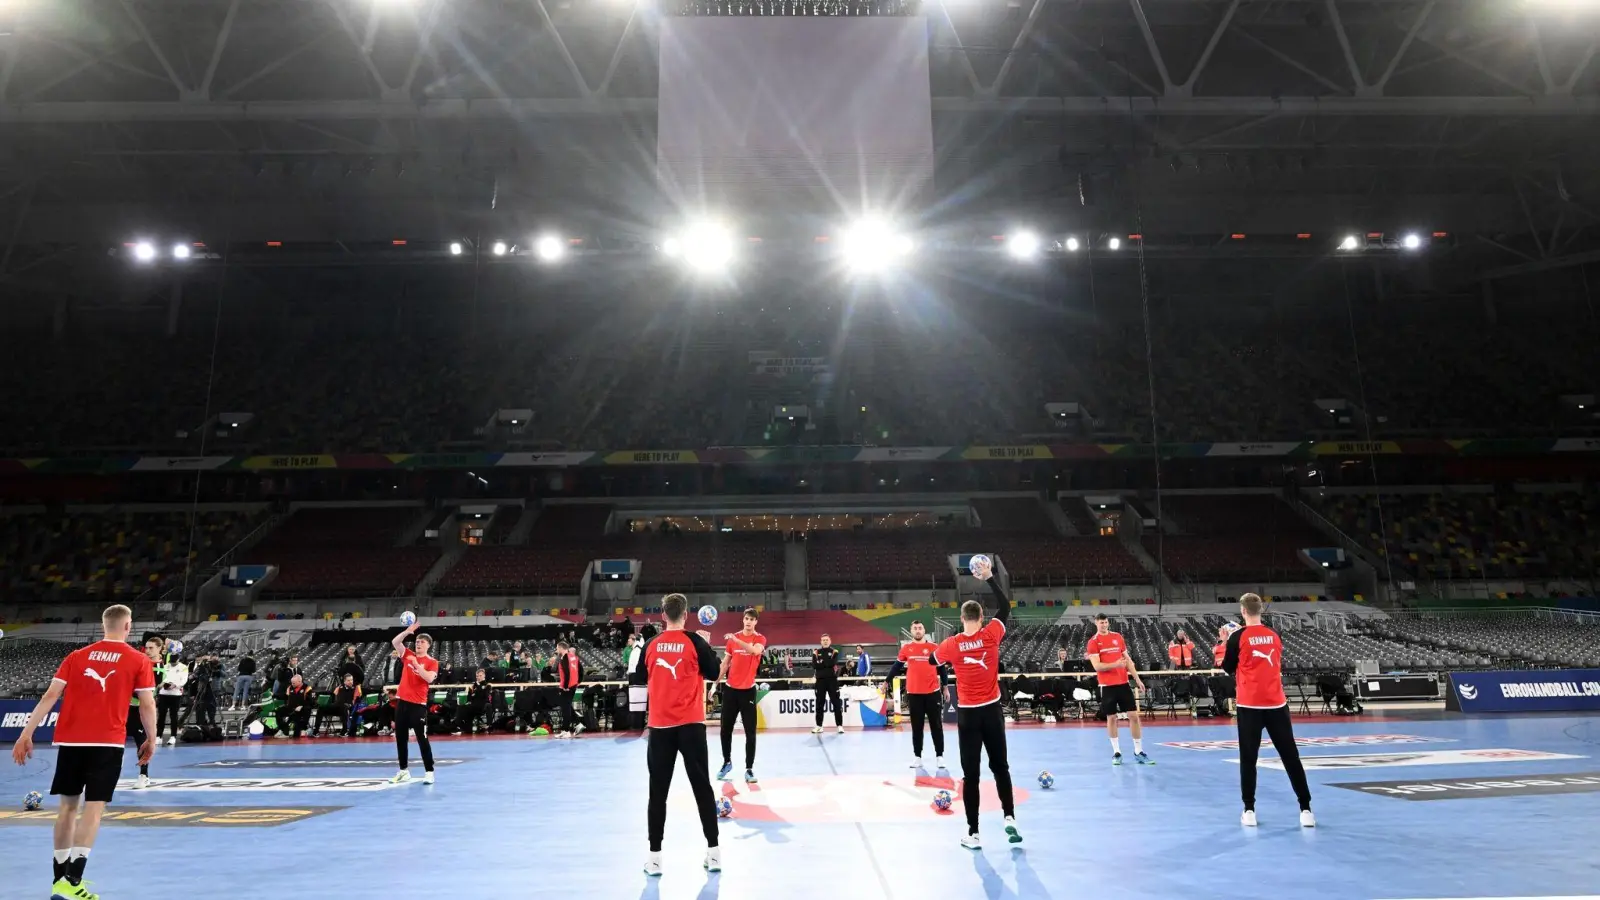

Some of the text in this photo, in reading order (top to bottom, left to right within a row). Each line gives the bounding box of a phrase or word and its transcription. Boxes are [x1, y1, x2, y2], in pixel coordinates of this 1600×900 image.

[633, 452, 680, 462] HERE TO PLAY
[959, 639, 984, 652] GERMANY
[1248, 635, 1274, 646] GERMANY
[656, 642, 685, 653] GERMANY
[88, 650, 122, 662] GERMANY
[1361, 776, 1600, 794] reenet
